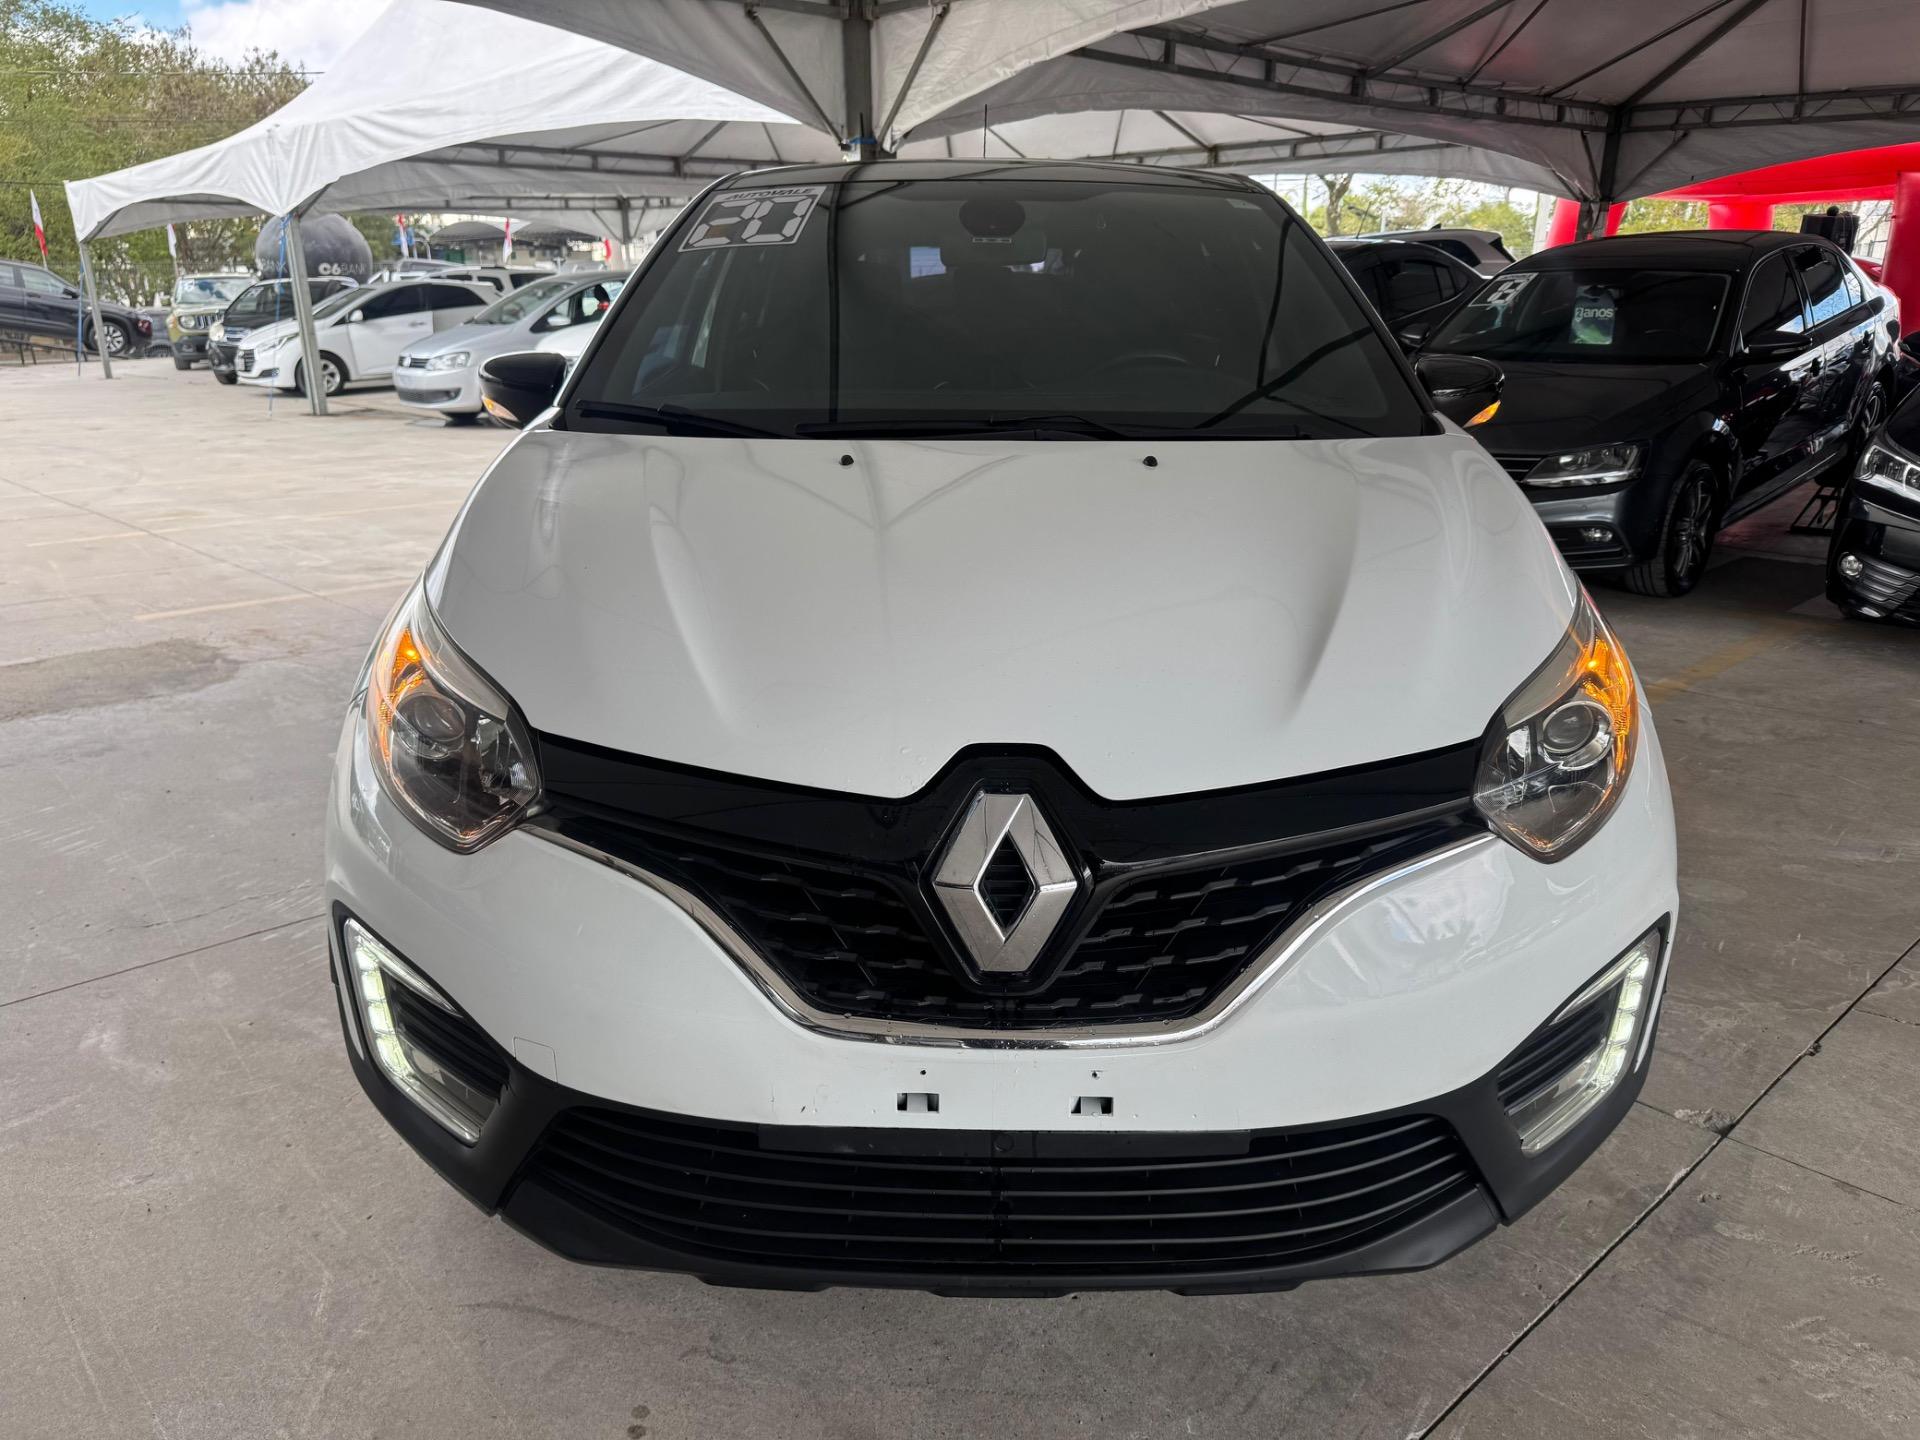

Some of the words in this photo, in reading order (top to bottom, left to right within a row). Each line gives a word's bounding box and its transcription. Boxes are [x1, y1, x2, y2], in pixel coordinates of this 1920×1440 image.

[727, 187, 816, 200] AUTOVALE
[688, 195, 813, 247] 20
[318, 262, 341, 276] C6
[1584, 308, 1614, 318] anos
